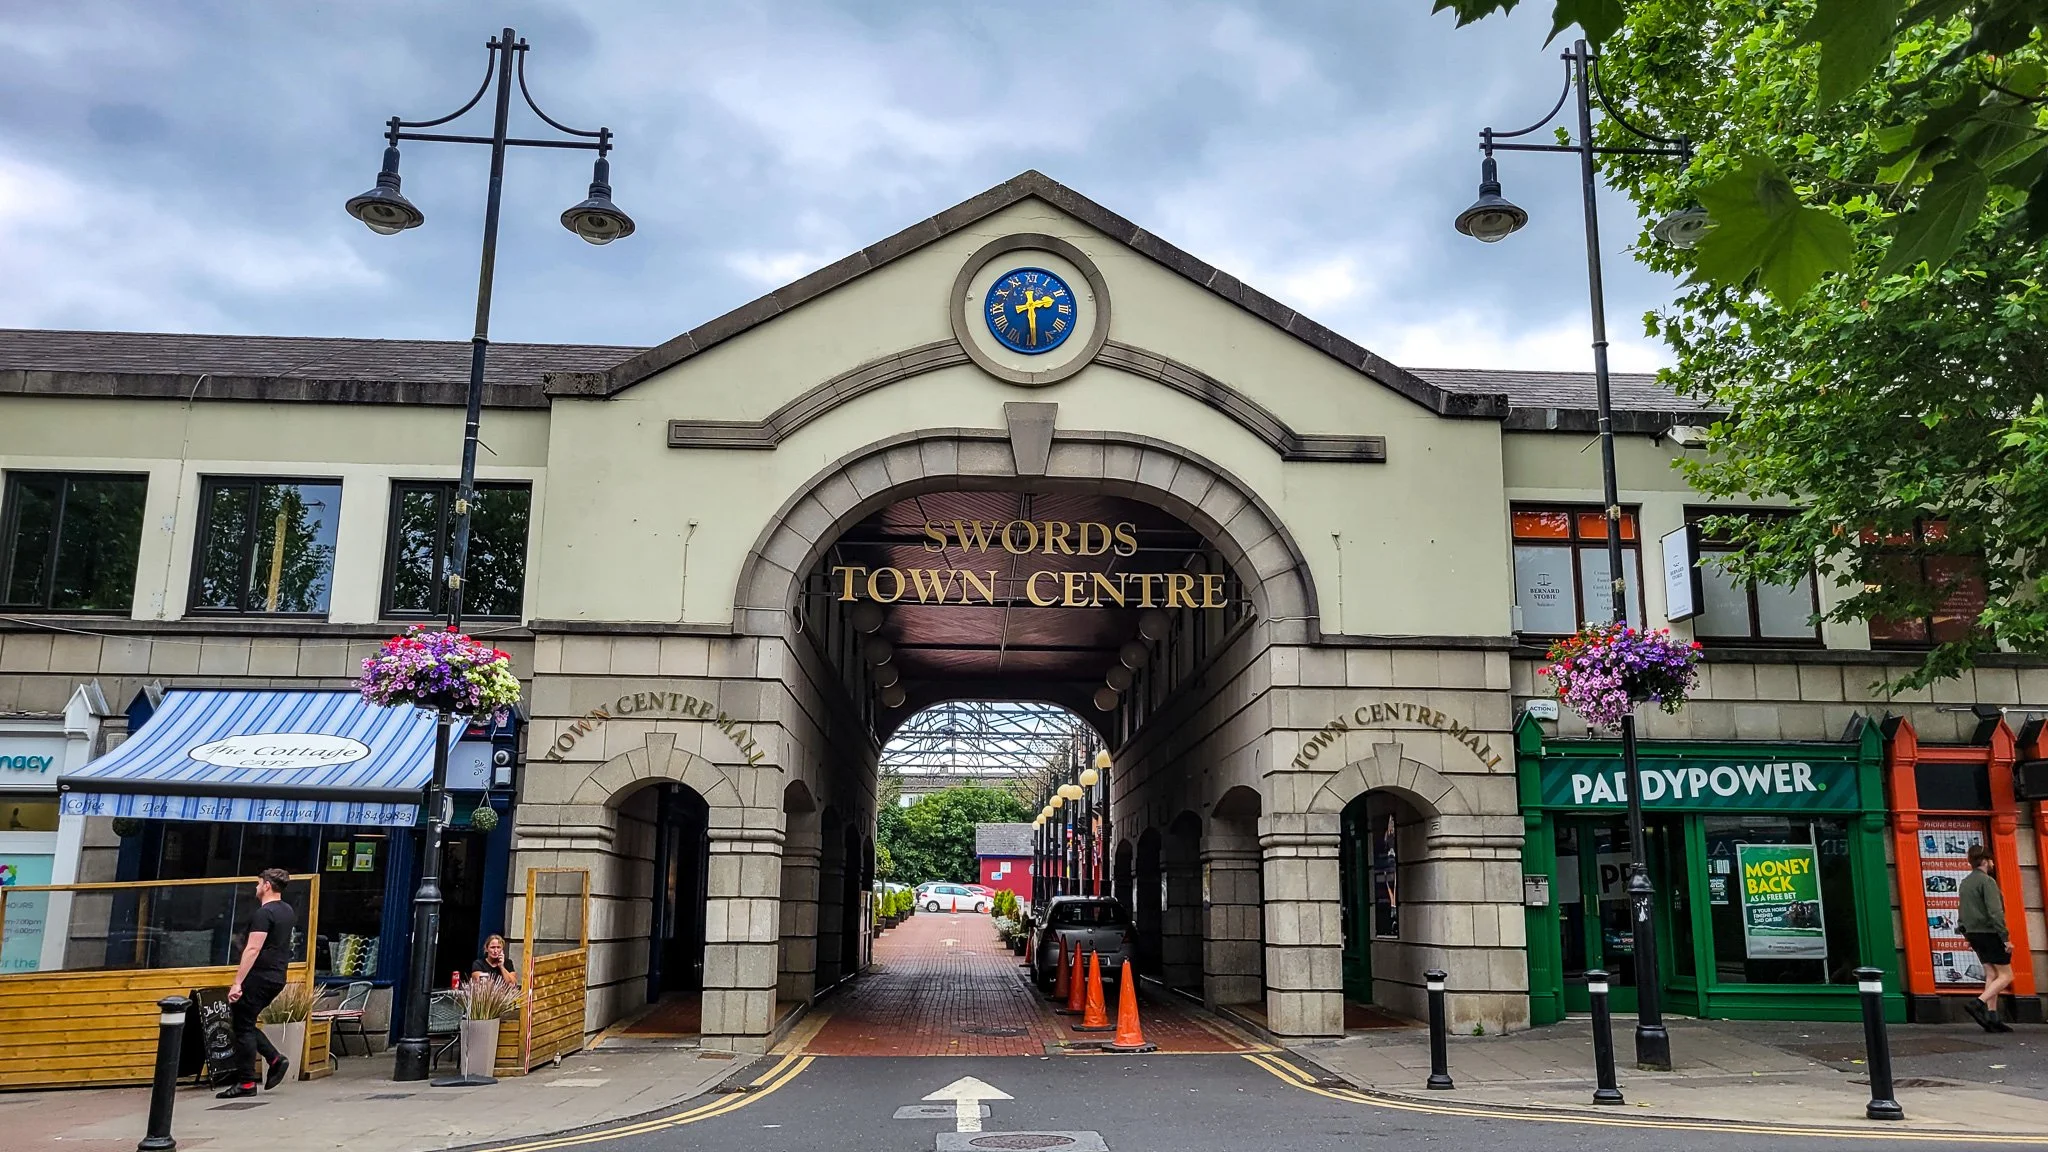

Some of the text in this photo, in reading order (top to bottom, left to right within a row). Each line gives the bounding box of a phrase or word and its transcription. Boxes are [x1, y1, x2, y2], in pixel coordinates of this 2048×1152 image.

[923, 518, 1138, 558] SWORDS
[832, 565, 1228, 609] TOWN CENTRE
[545, 691, 765, 768] TOWN CENTRE MALL
[1291, 702, 1502, 772] TOWN CENTRE MALL
[206, 745, 358, 760] The Cottage
[67, 799, 104, 812] Coffee
[142, 802, 168, 813] Deli
[258, 806, 321, 820] Takeaway
[1746, 858, 1810, 878] MONEY
[1746, 876, 1795, 894] BACK
[14, 958, 37, 968] the
